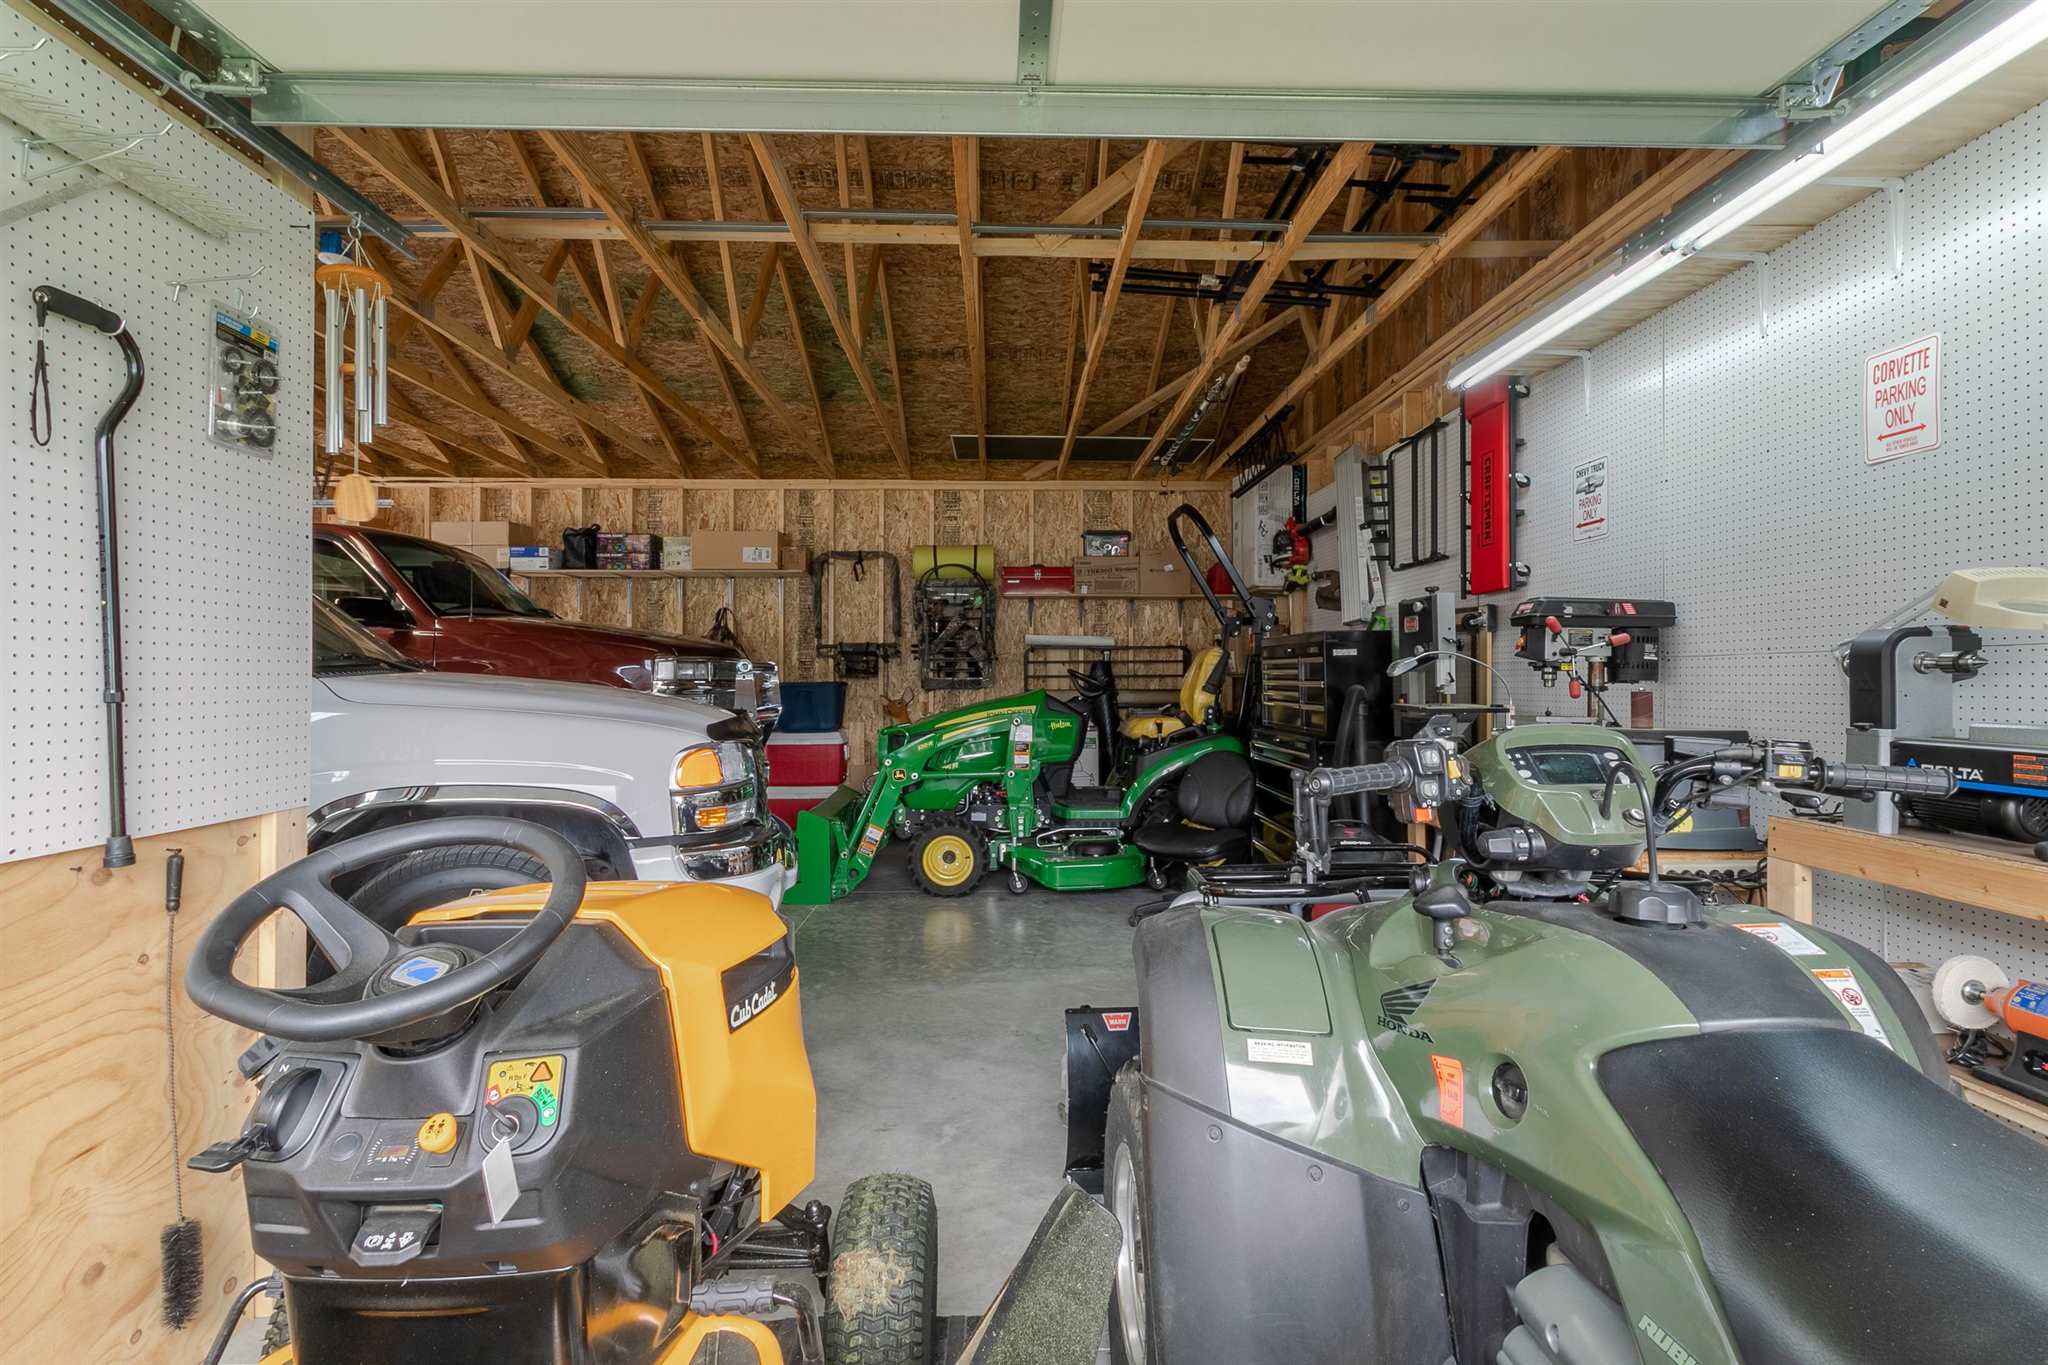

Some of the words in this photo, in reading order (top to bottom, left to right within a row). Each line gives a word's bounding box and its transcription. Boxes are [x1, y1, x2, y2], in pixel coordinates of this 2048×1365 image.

[1872, 347, 1930, 385] CORVETTE
[1875, 376, 1927, 408] PARKING
[1885, 402, 1916, 428] ONLY
[1576, 467, 1590, 479] CHEVY
[1591, 462, 1605, 473] TRUCK
[1579, 493, 1601, 510] PARKING
[1583, 507, 1599, 521] ONLY
[730, 999, 752, 1028] Cub
[751, 981, 778, 1015] Cadet
[1376, 1015, 1434, 1044] HONDA
[279, 1064, 290, 1073] N
